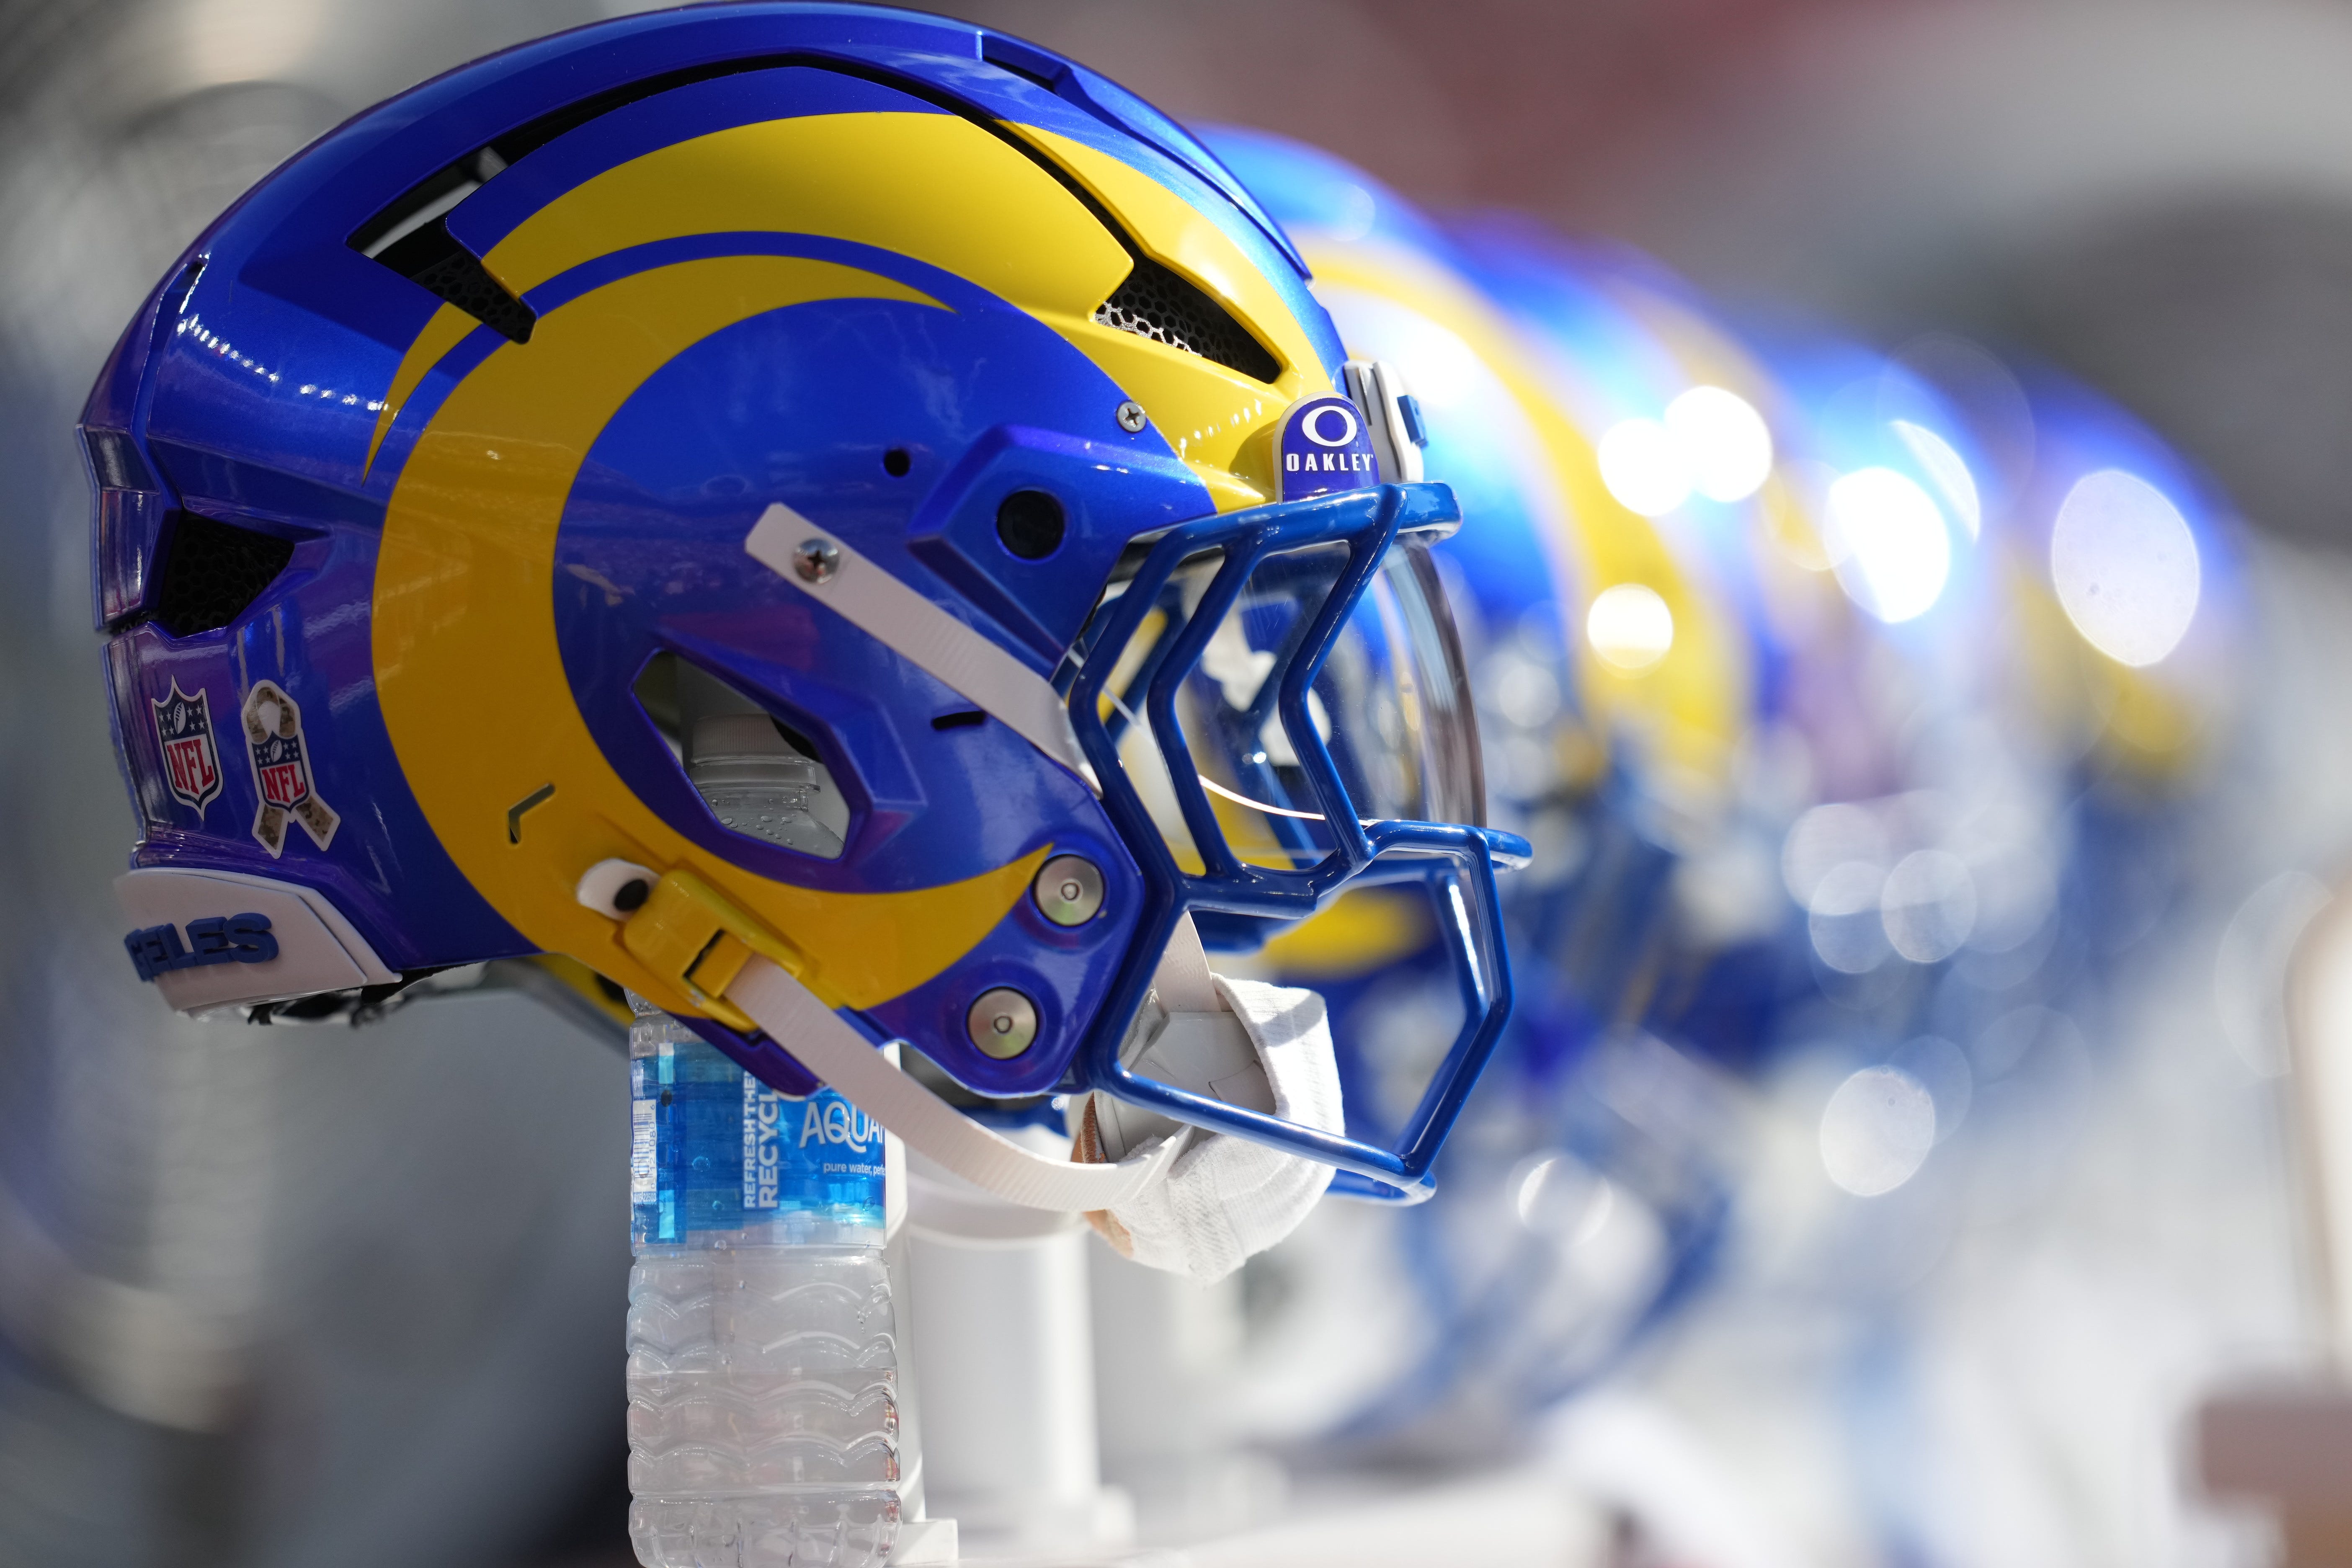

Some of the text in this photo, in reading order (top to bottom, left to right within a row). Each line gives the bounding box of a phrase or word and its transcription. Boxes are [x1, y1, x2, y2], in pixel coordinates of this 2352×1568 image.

[1287, 454, 1371, 472] OAKLEY
[167, 739, 214, 795] NFL
[261, 764, 305, 803] NFL
[744, 1119, 756, 1208] REFRESH
[823, 1163, 846, 1173] pure
[849, 1163, 872, 1176] water,
